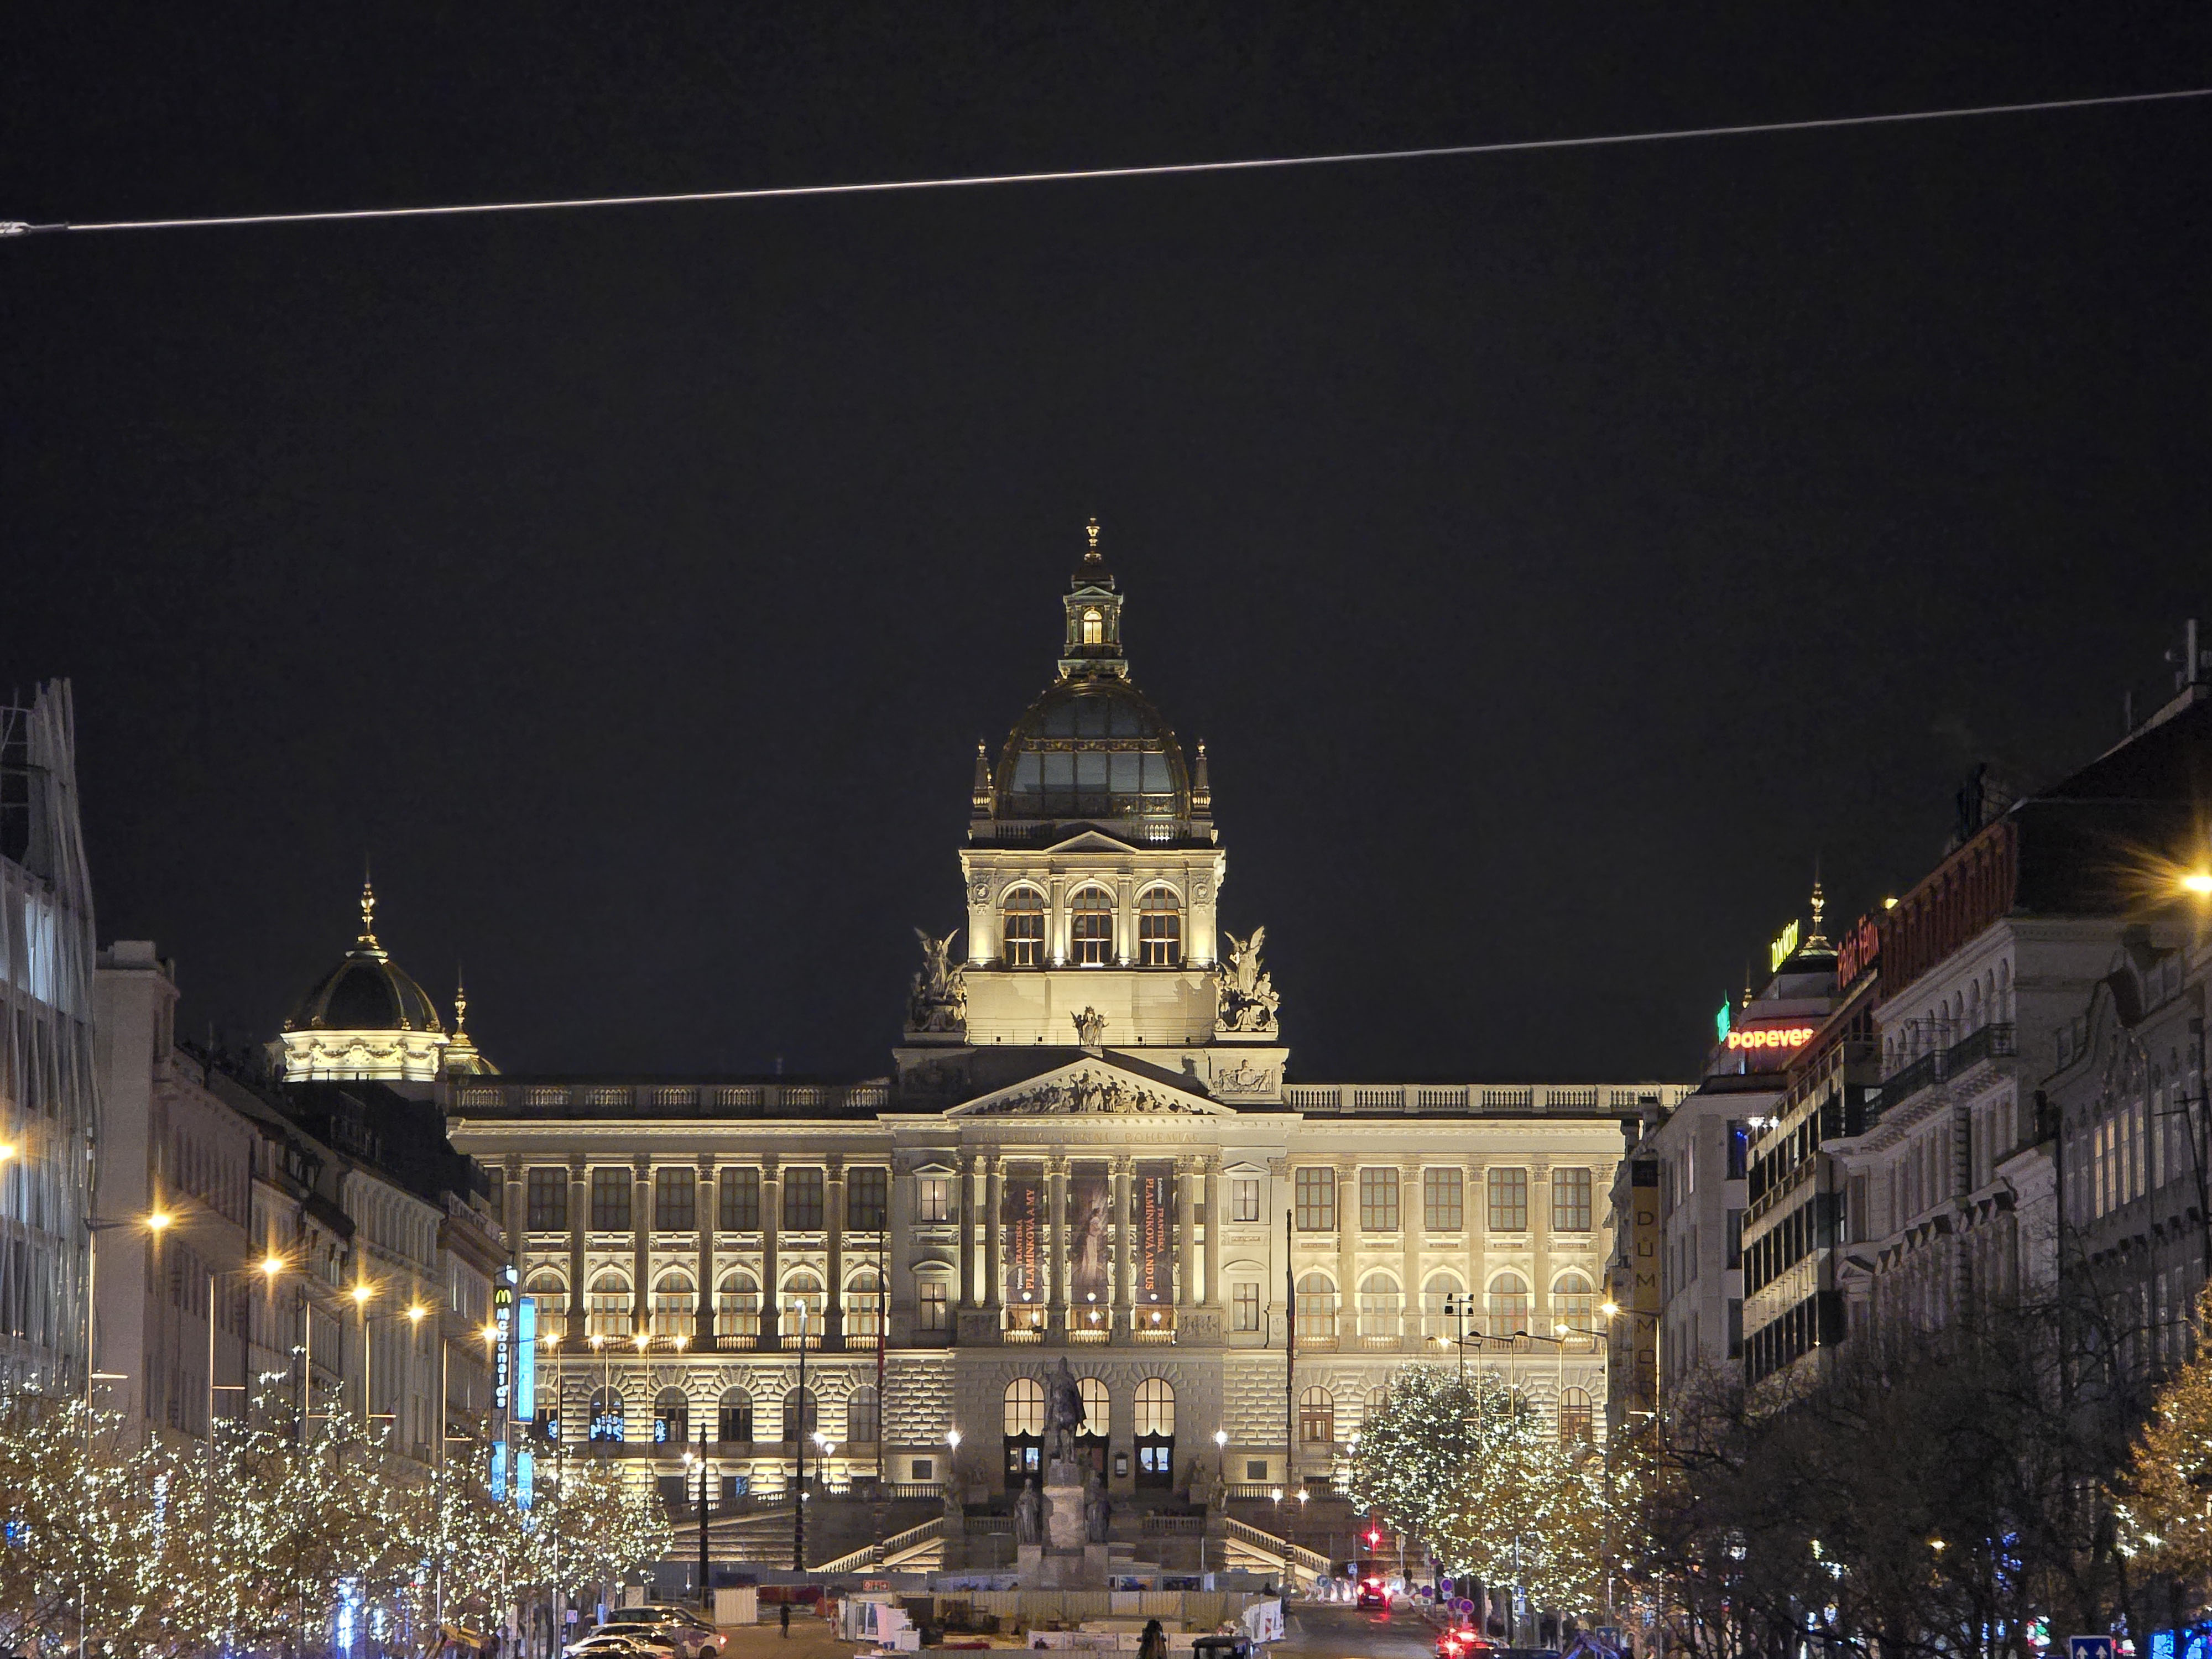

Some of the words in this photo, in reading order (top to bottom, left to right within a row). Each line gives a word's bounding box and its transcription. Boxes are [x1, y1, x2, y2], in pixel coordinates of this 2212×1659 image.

[1125, 1132, 1199, 1142] BOHEMIAE
[1026, 1189, 1035, 1206] MY
[1026, 1207, 1035, 1217] A
[1145, 1177, 1156, 1249] PLAMÍNKOVÁ
[1015, 1219, 1024, 1264] FRANTIŠKA
[1157, 1207, 1166, 1254] FRANTIŠKA
[1636, 1211, 1656, 1288] DŮM
[1024, 1218, 1035, 1290] PLAMÍNKOVÁ
[1145, 1251, 1154, 1275] AND
[1145, 1275, 1154, 1291] US
[495, 1307, 510, 1408] McDonald's
